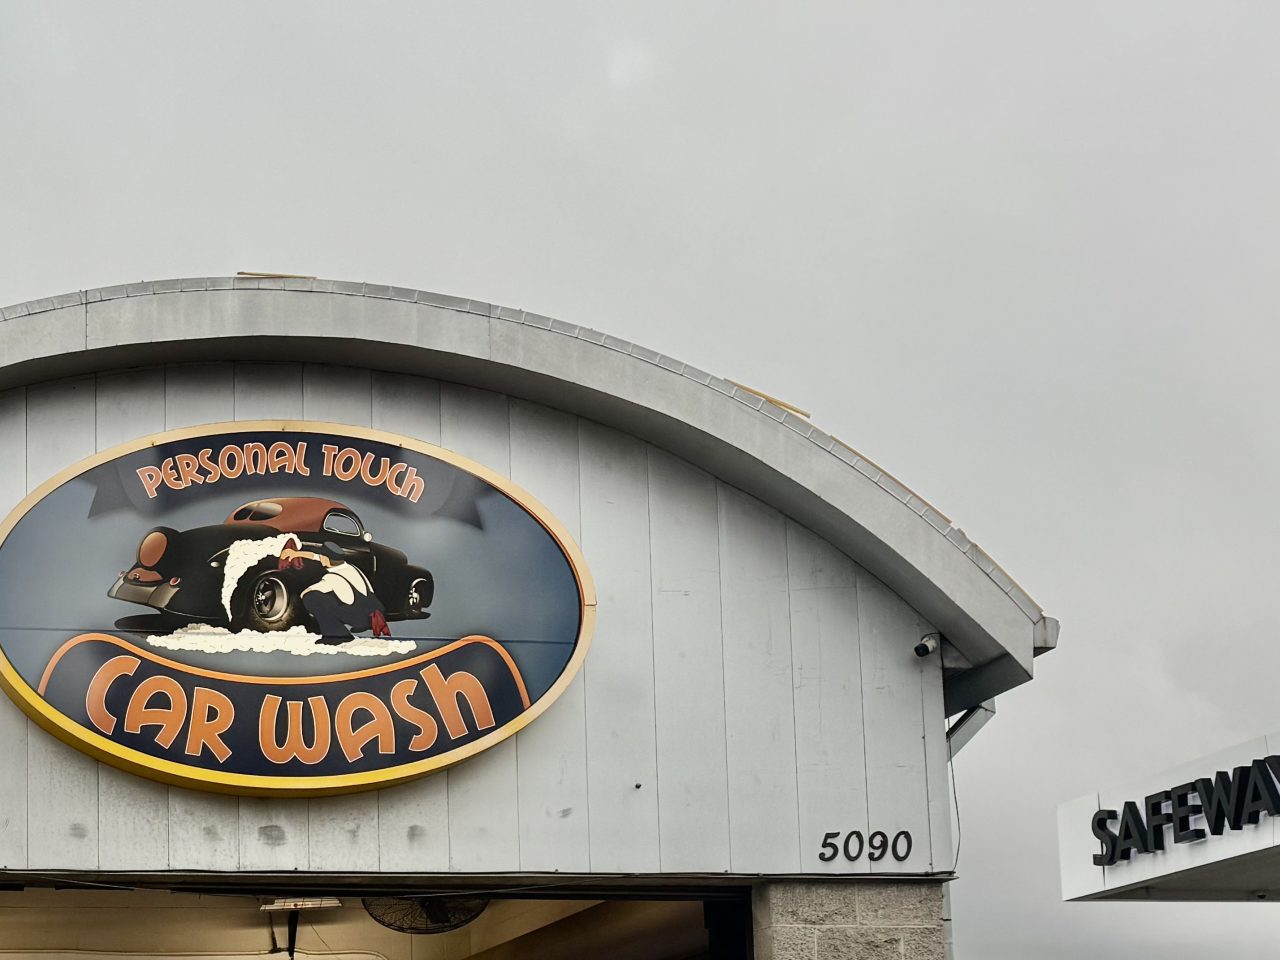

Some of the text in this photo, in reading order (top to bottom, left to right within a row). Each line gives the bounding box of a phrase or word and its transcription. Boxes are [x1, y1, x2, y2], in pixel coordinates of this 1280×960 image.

[136, 442, 426, 503] PERSONAL TOUCH
[85, 655, 496, 764] CAR WASH
[819, 830, 912, 862] 5090
